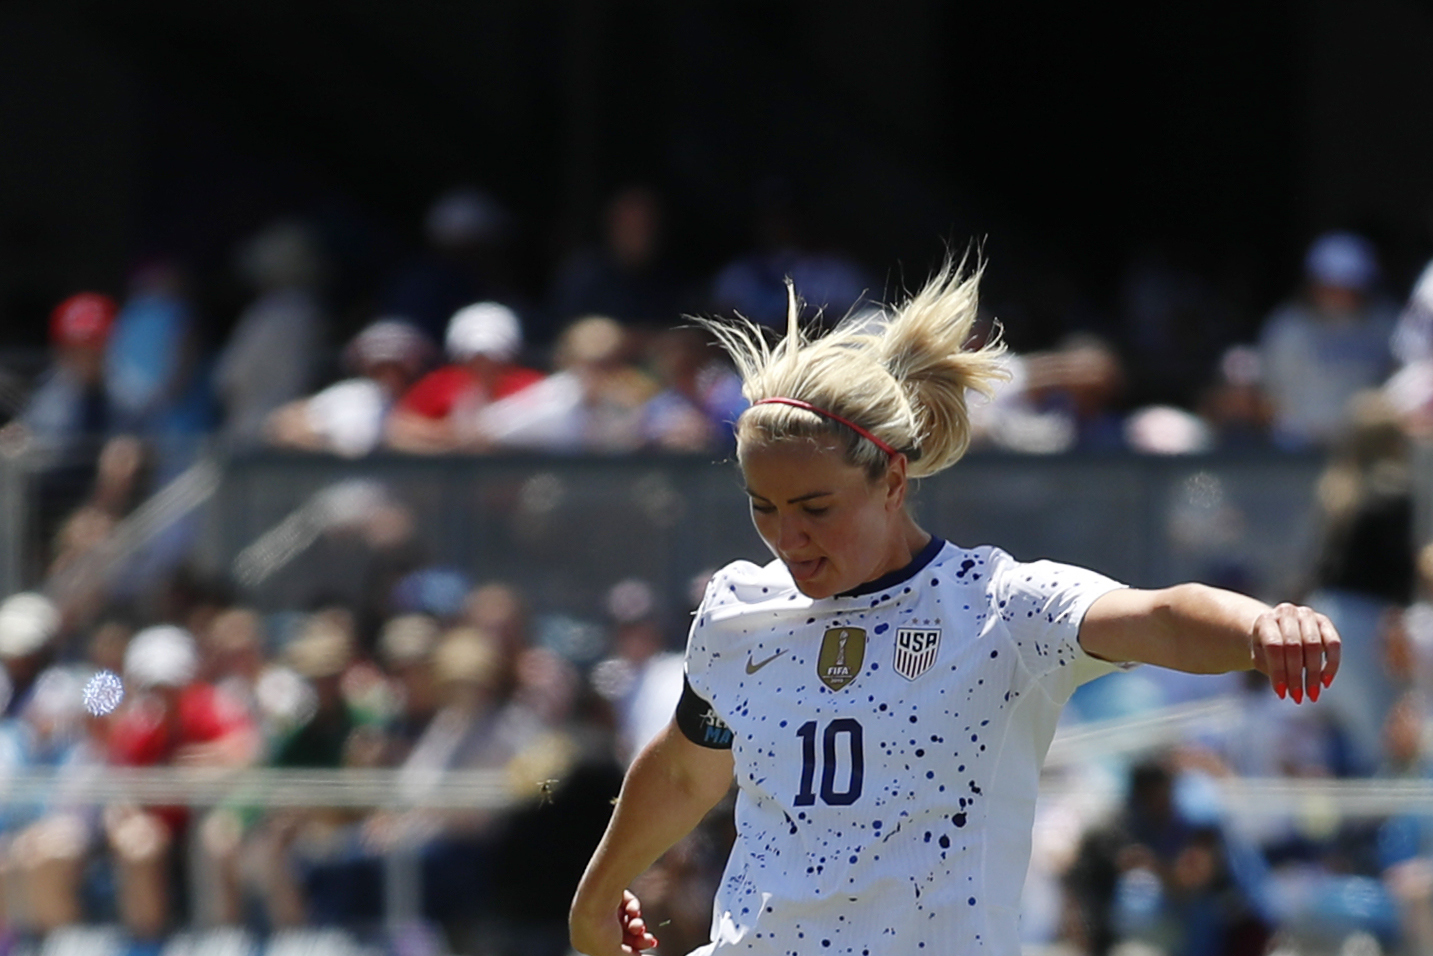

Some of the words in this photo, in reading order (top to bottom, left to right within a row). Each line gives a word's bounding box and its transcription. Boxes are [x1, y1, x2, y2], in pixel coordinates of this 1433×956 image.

[899, 631, 938, 653] USA
[827, 666, 850, 676] FIFA
[793, 718, 864, 807] 10
